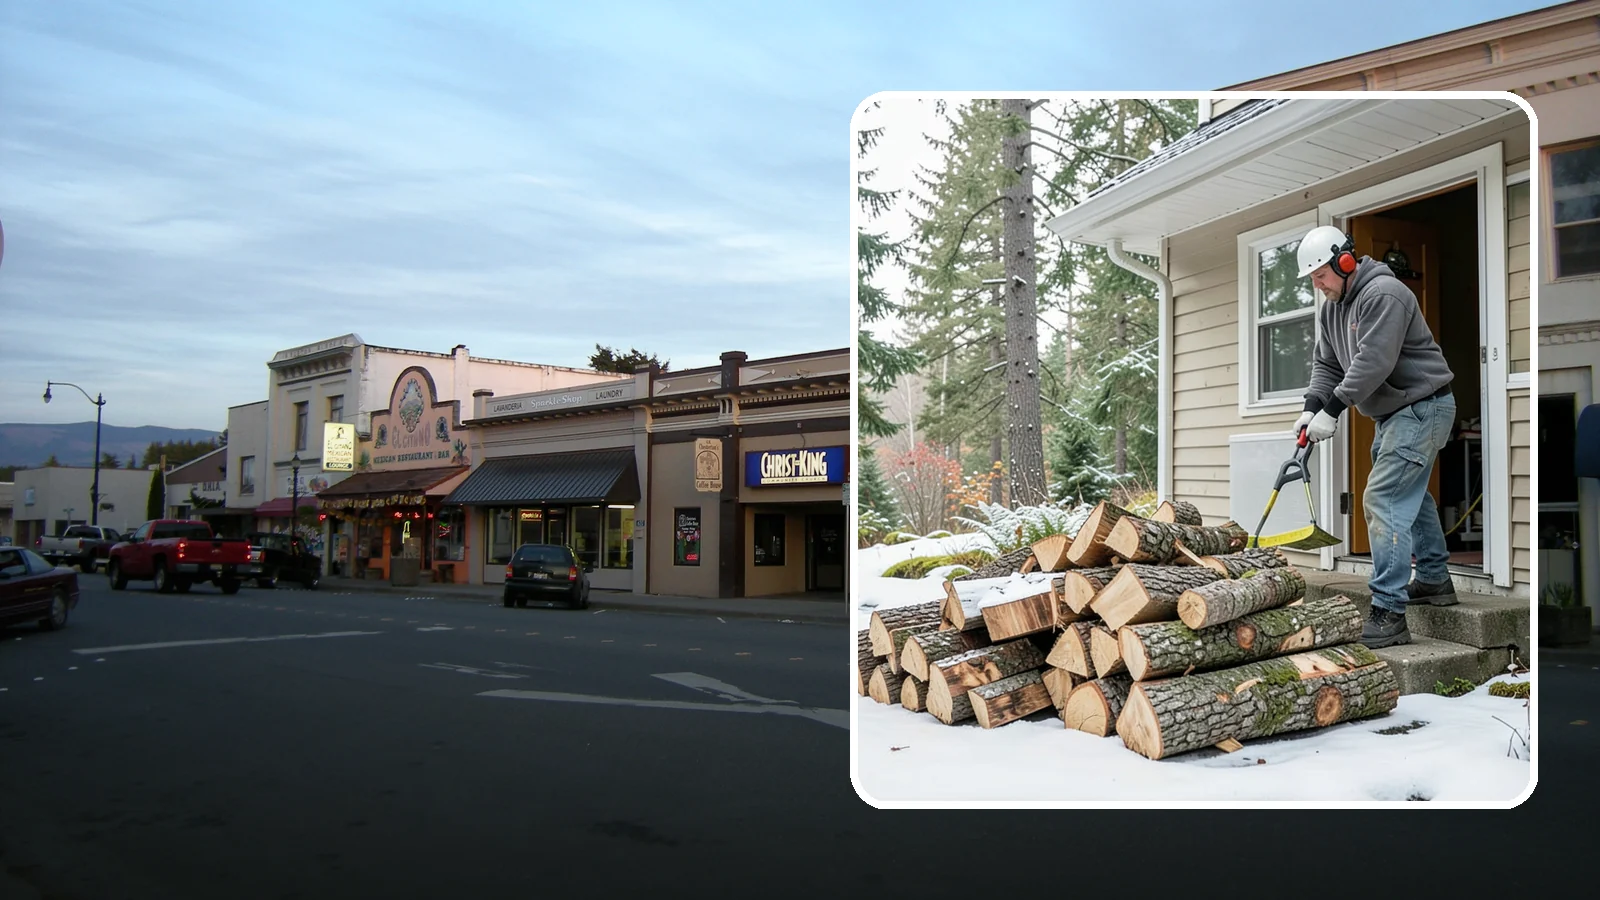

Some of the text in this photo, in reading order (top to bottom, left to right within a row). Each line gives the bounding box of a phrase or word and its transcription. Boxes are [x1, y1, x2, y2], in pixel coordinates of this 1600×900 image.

[595, 389, 623, 400] LAUNDRY
[493, 402, 522, 413] LAVANDERIA
[530, 394, 583, 409] Sparkle Shop
[397, 451, 434, 462] RESTAURANT
[437, 450, 450, 459] BAR
[761, 450, 827, 478] CHRIST KING
